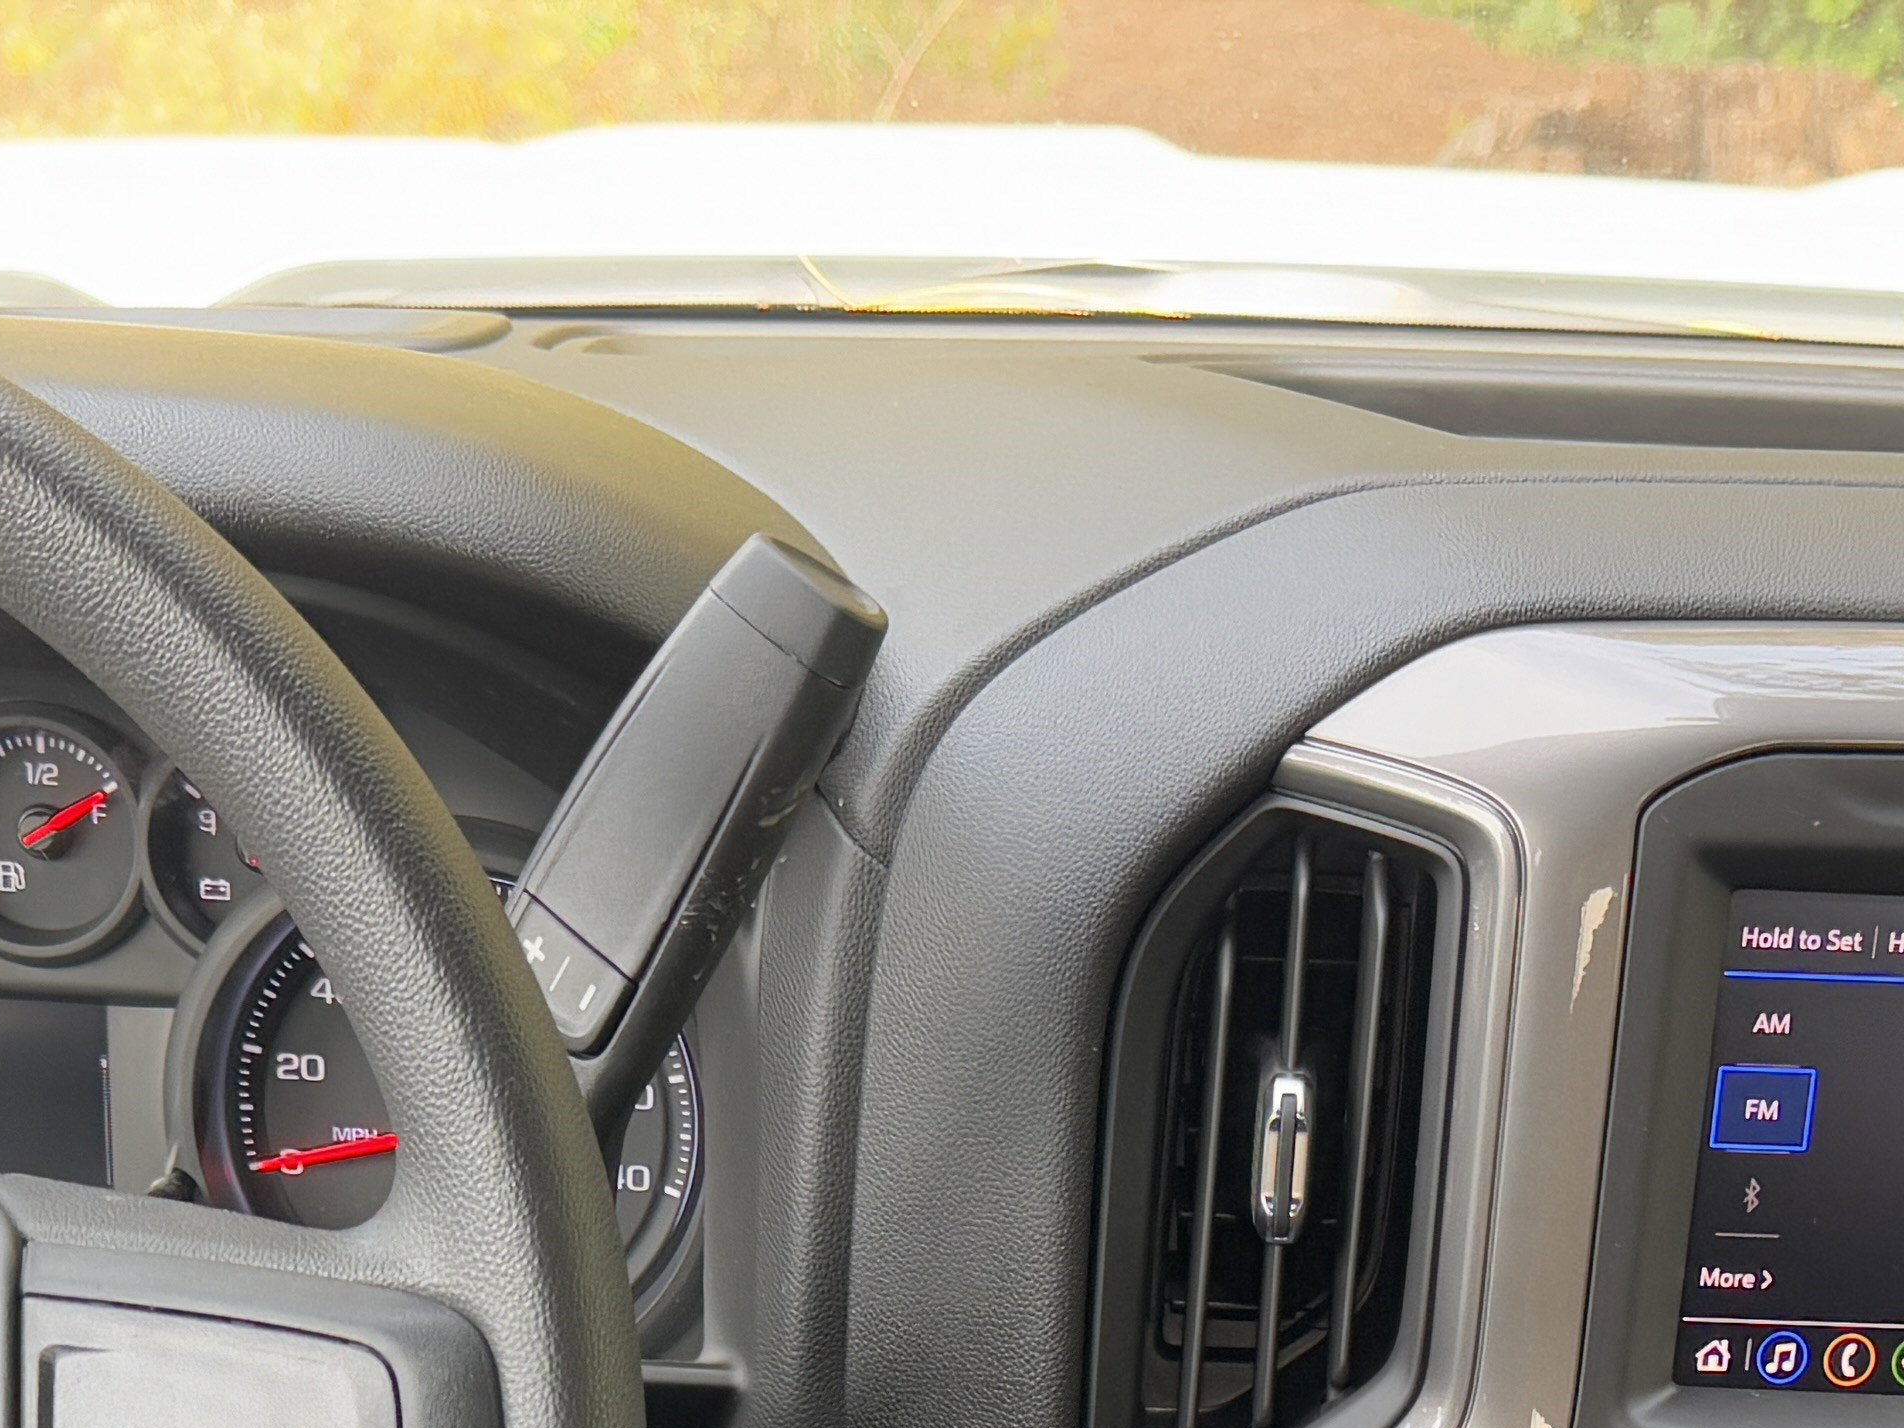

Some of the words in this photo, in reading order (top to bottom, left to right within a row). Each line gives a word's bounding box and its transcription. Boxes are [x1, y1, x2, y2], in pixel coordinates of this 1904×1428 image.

[25, 762, 59, 787] 1/2
[199, 809, 217, 836] 9
[1741, 927, 1793, 950] Hold
[1798, 930, 1821, 952] to
[1826, 930, 1863, 953] Set
[310, 978, 342, 1005] 4
[1752, 1012, 1791, 1035] AM
[276, 1053, 326, 1082] 20
[1745, 1098, 1779, 1122] FM
[1699, 1266, 1756, 1290] More
